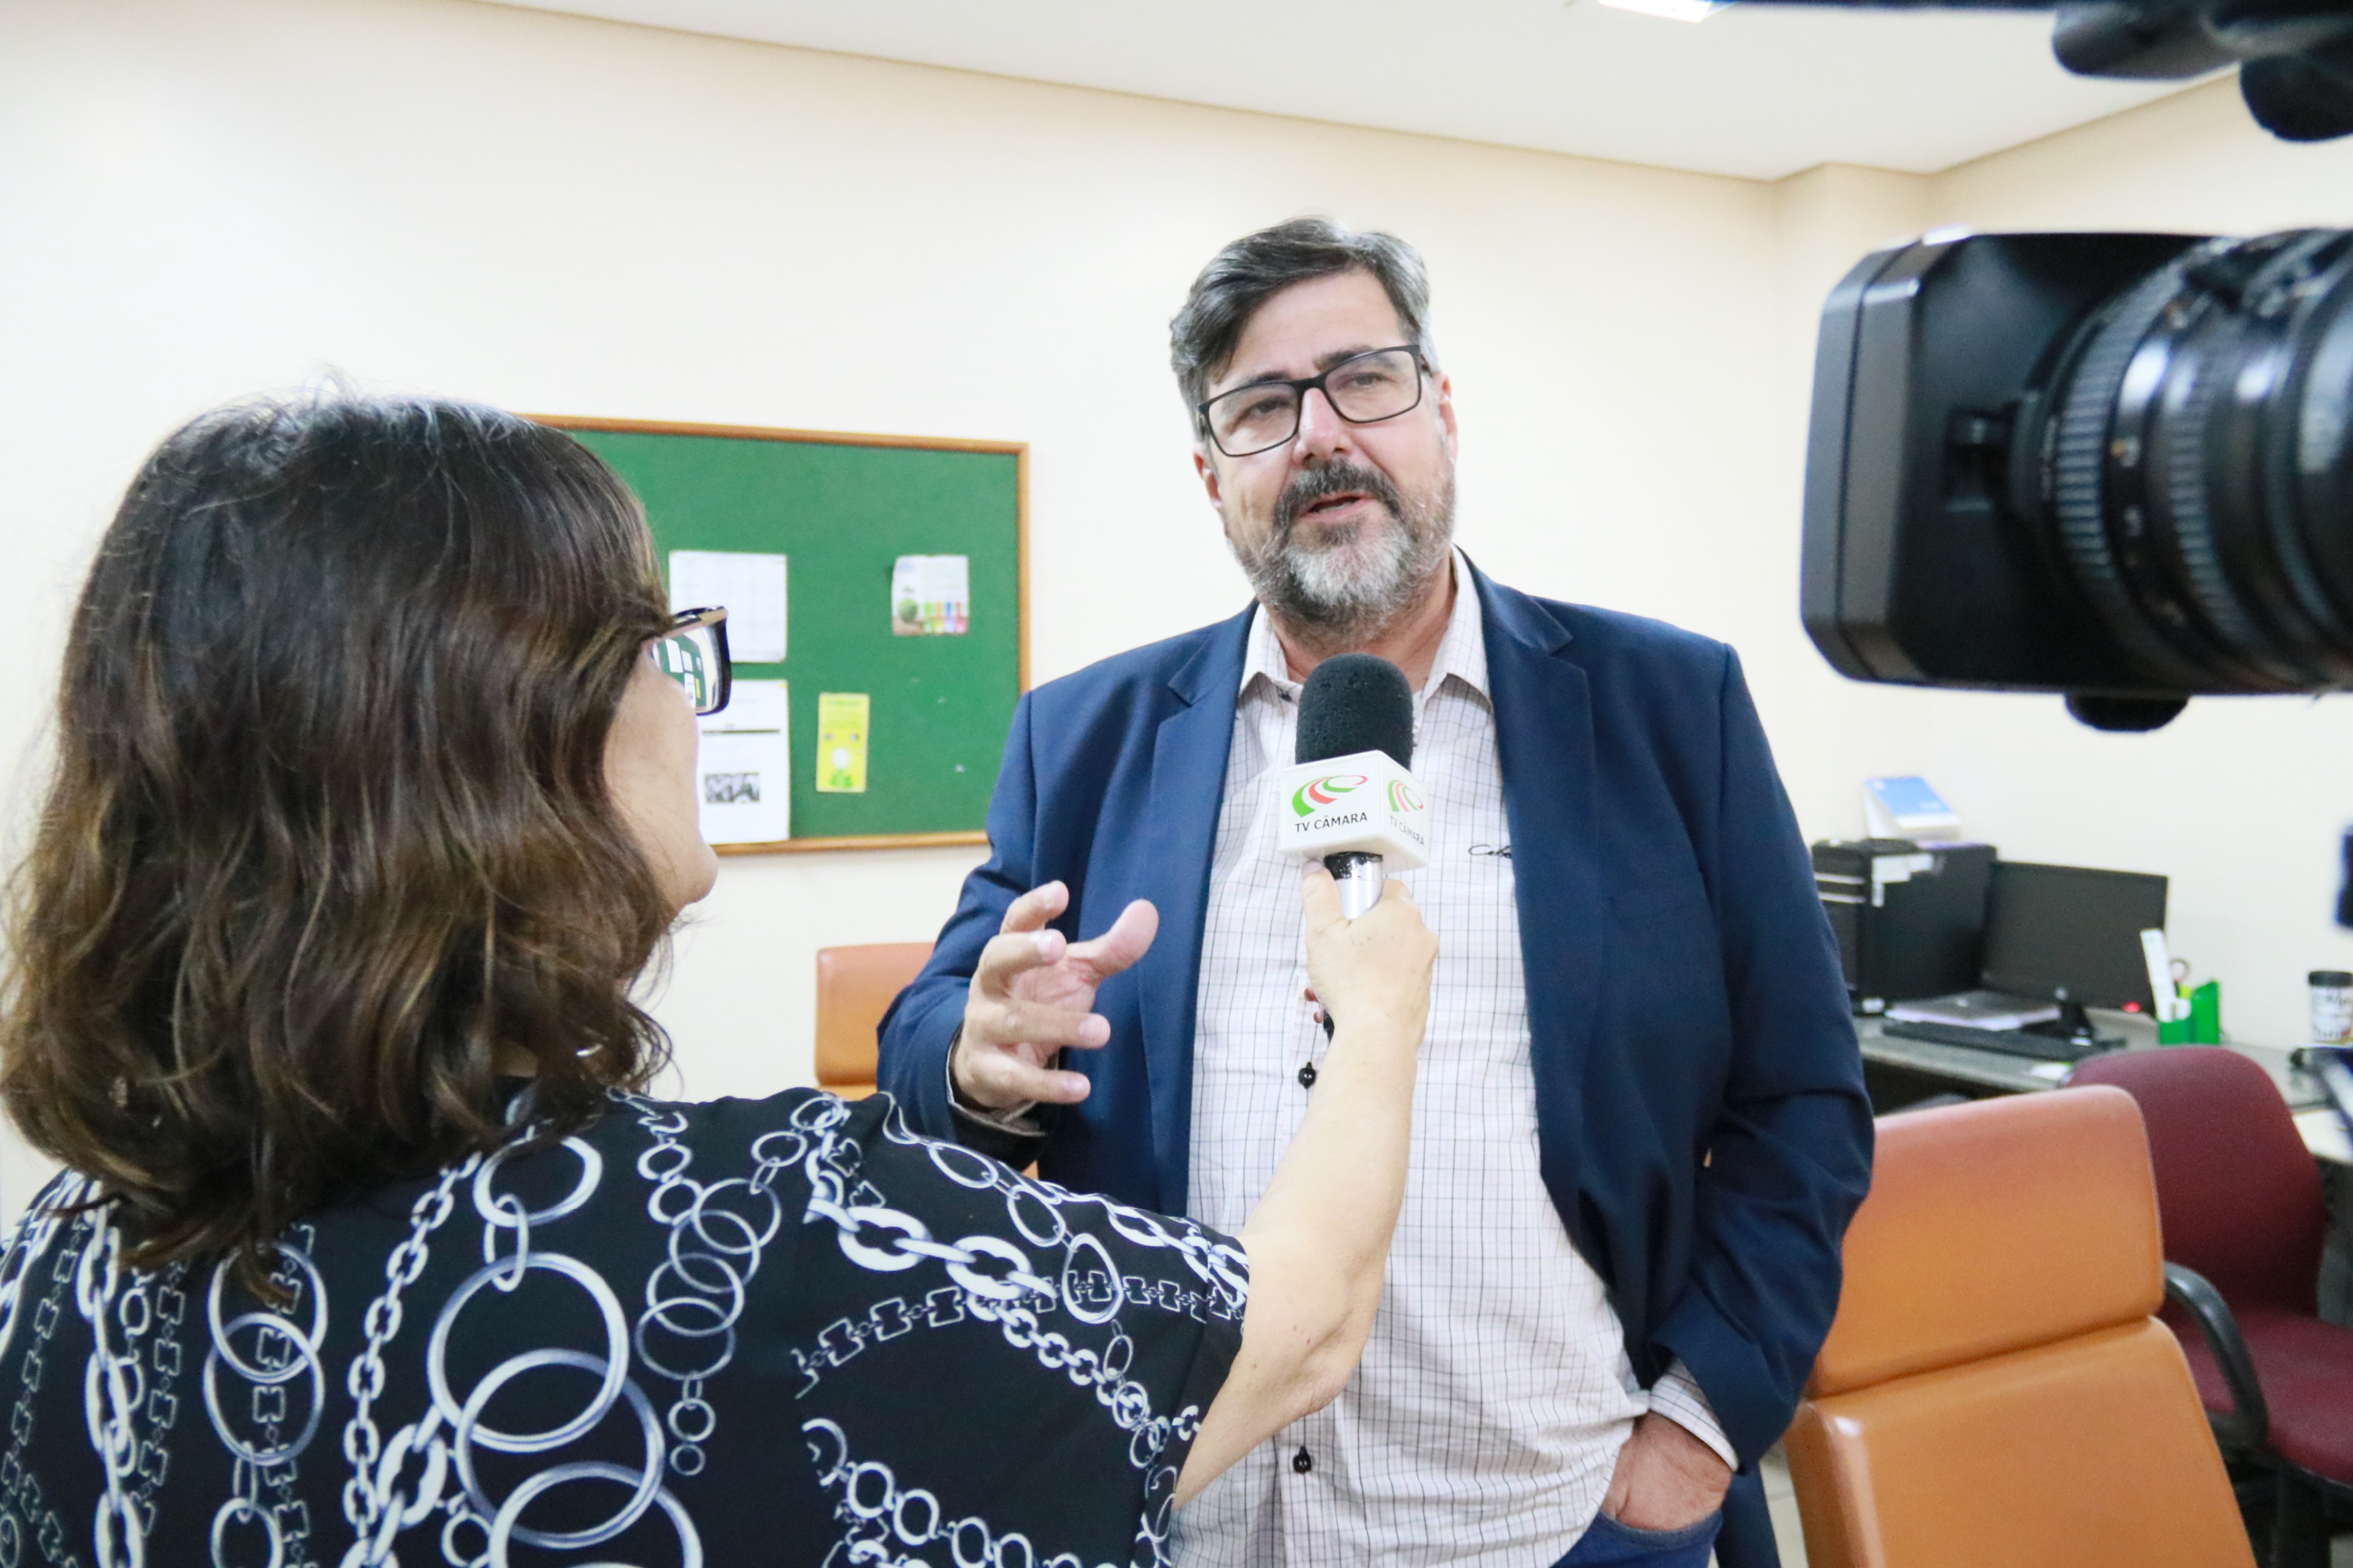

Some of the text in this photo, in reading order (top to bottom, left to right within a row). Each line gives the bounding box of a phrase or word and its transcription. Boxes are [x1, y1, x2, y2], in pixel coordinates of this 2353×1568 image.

[1294, 812, 1368, 833] TV CÂMARA
[1389, 815, 1425, 846] TV CÂMARA
